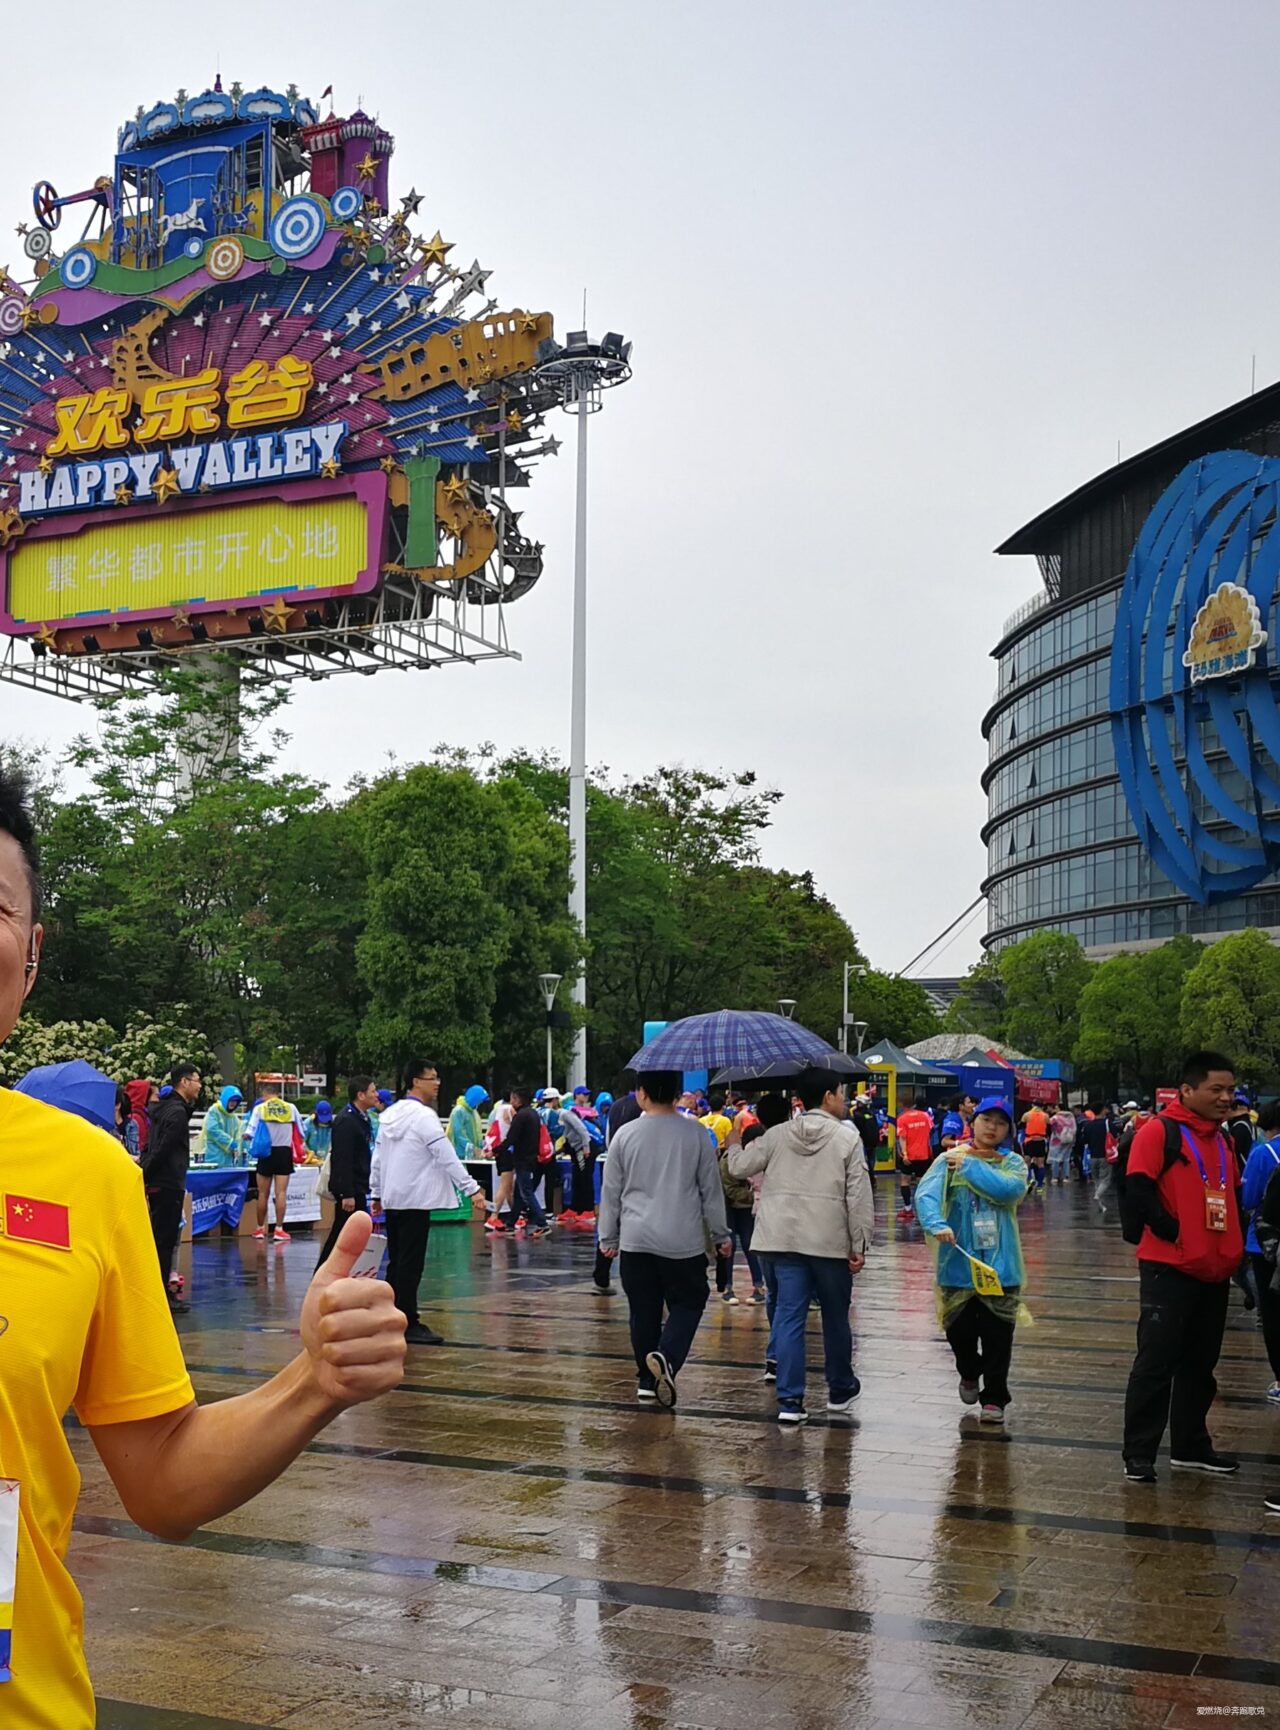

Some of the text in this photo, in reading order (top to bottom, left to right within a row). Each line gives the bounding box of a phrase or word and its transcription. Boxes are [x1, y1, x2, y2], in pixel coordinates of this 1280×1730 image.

[46, 355, 313, 456] 欢乐谷
[20, 421, 346, 512] HAPPY VALLEY
[46, 519, 340, 592] 繁华都市开心地
